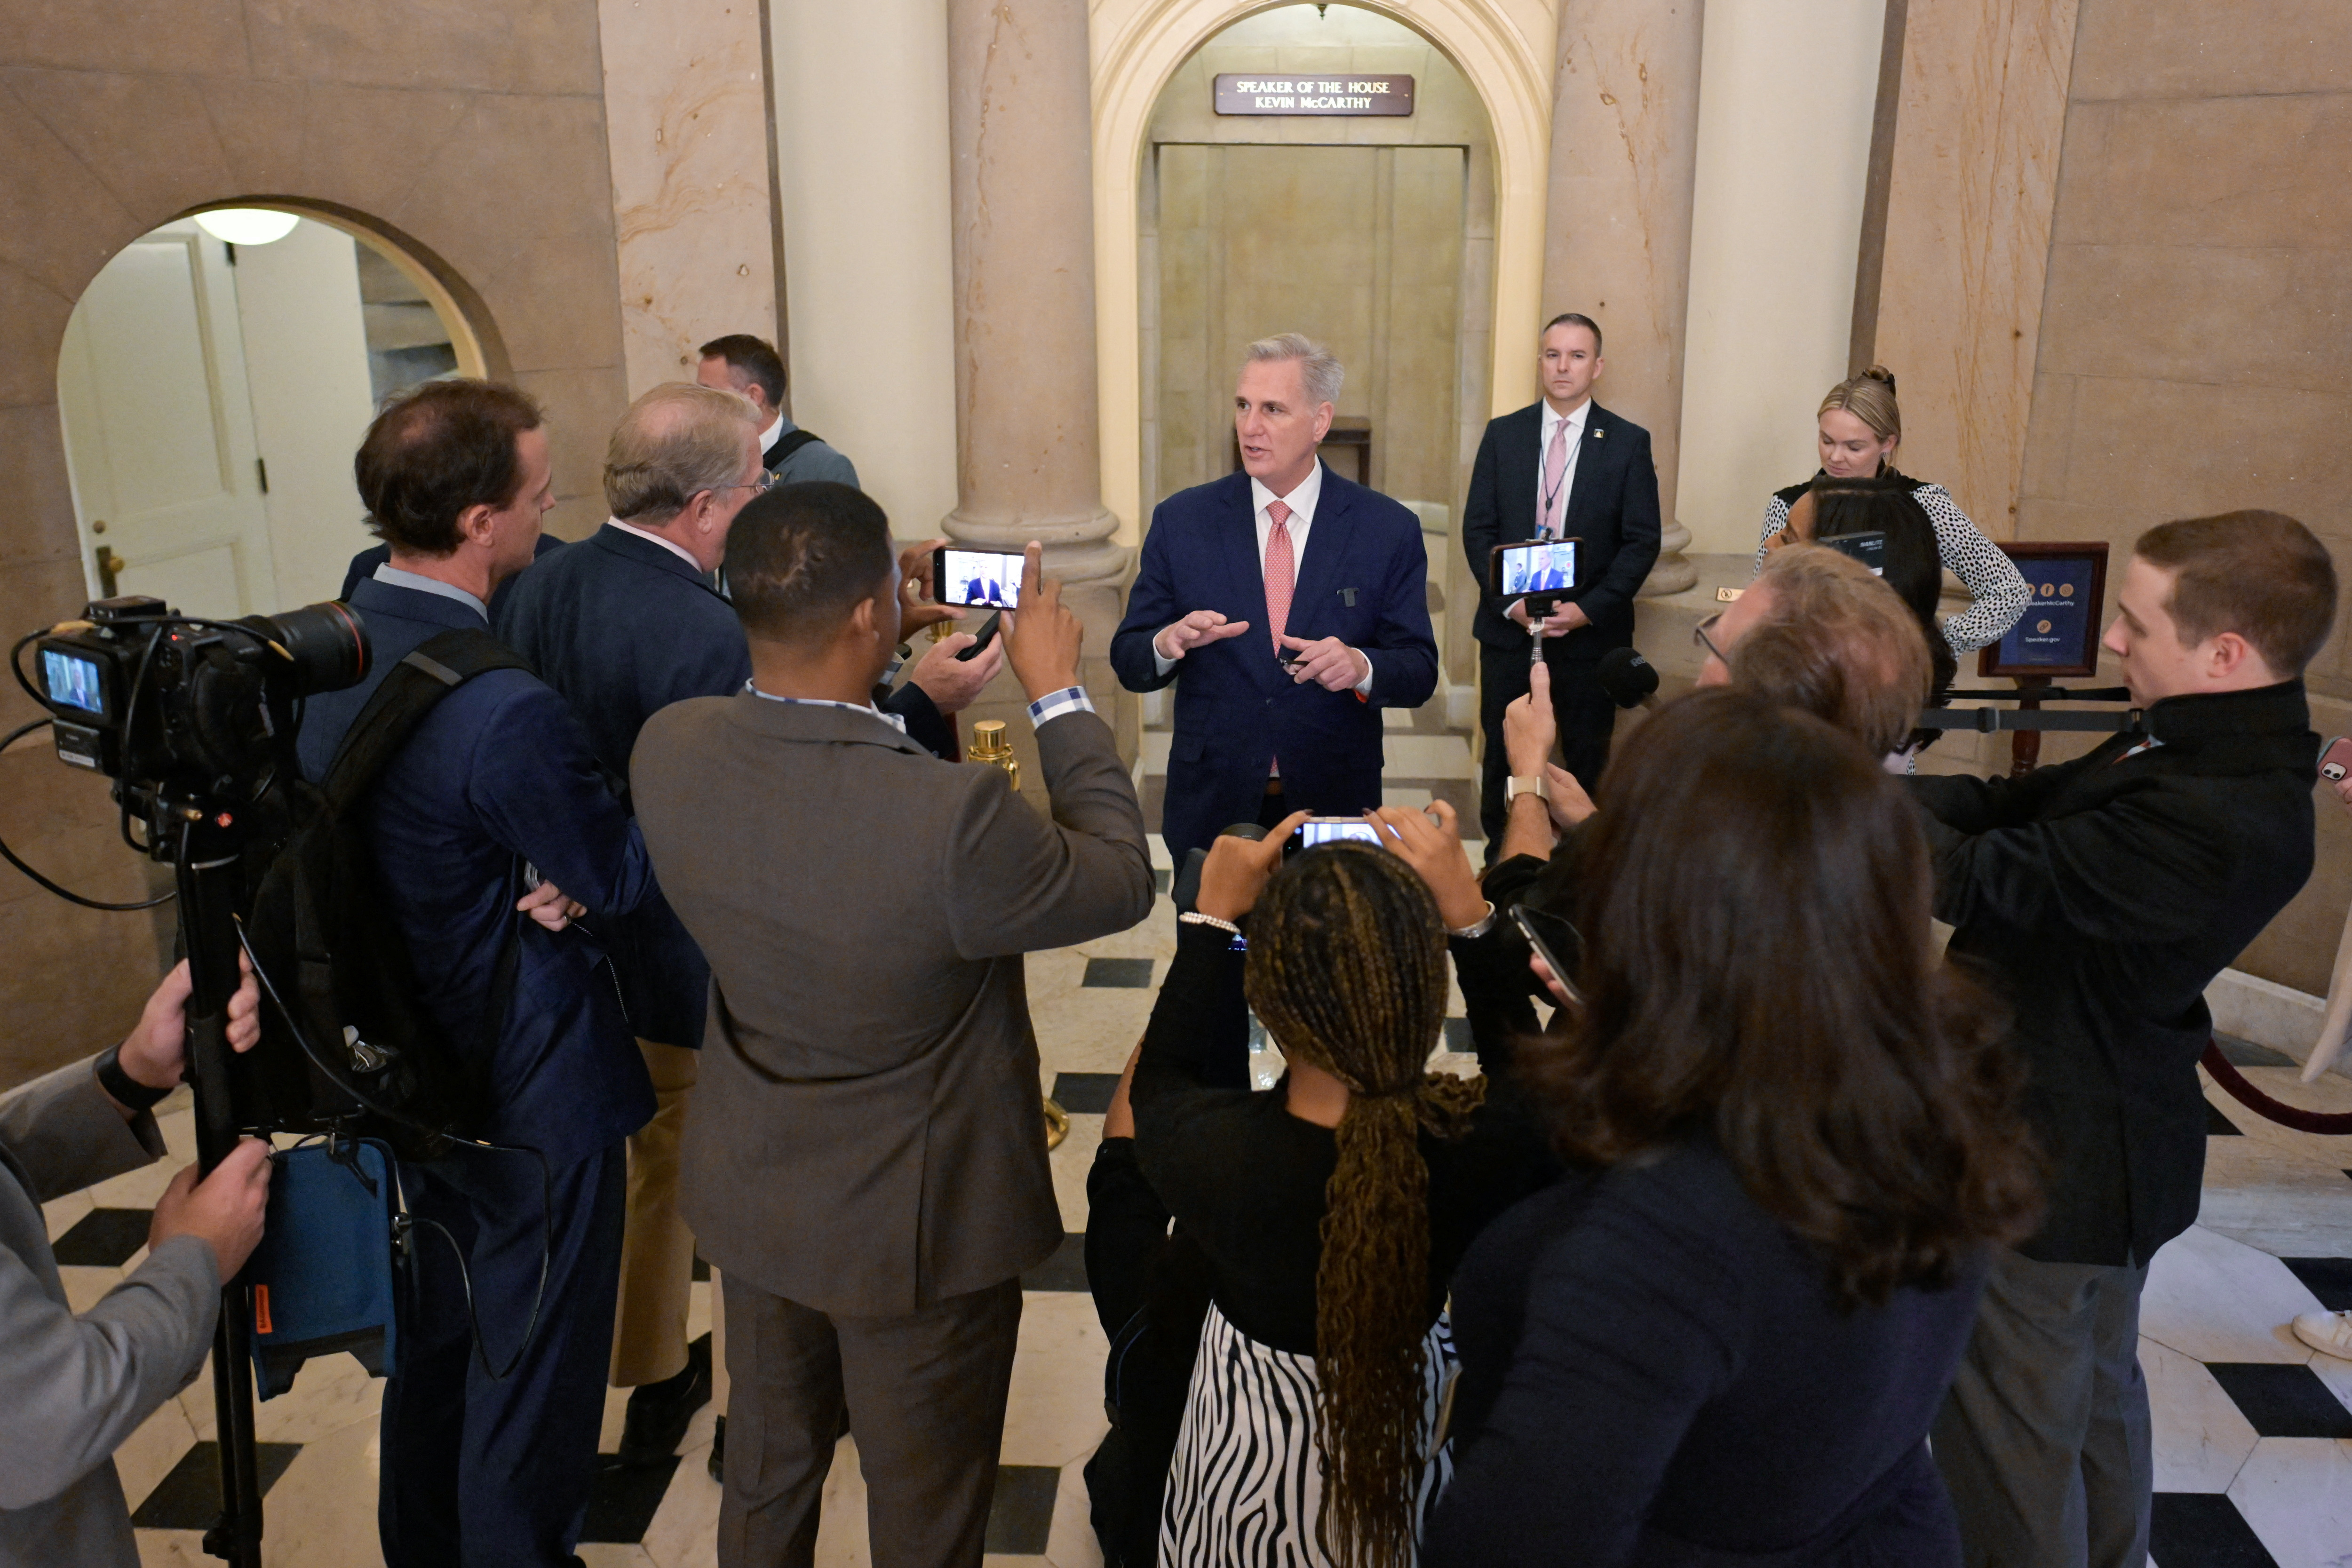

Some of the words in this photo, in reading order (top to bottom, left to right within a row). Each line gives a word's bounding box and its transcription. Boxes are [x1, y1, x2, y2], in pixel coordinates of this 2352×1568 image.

[1237, 81, 1294, 93] SPEAKER
[1297, 81, 1315, 93] OF
[1318, 82, 1343, 93] THE
[1348, 82, 1391, 93] HOUSE
[1255, 97, 1295, 108] KEVIN
[1301, 97, 1371, 108] McCARTHY
